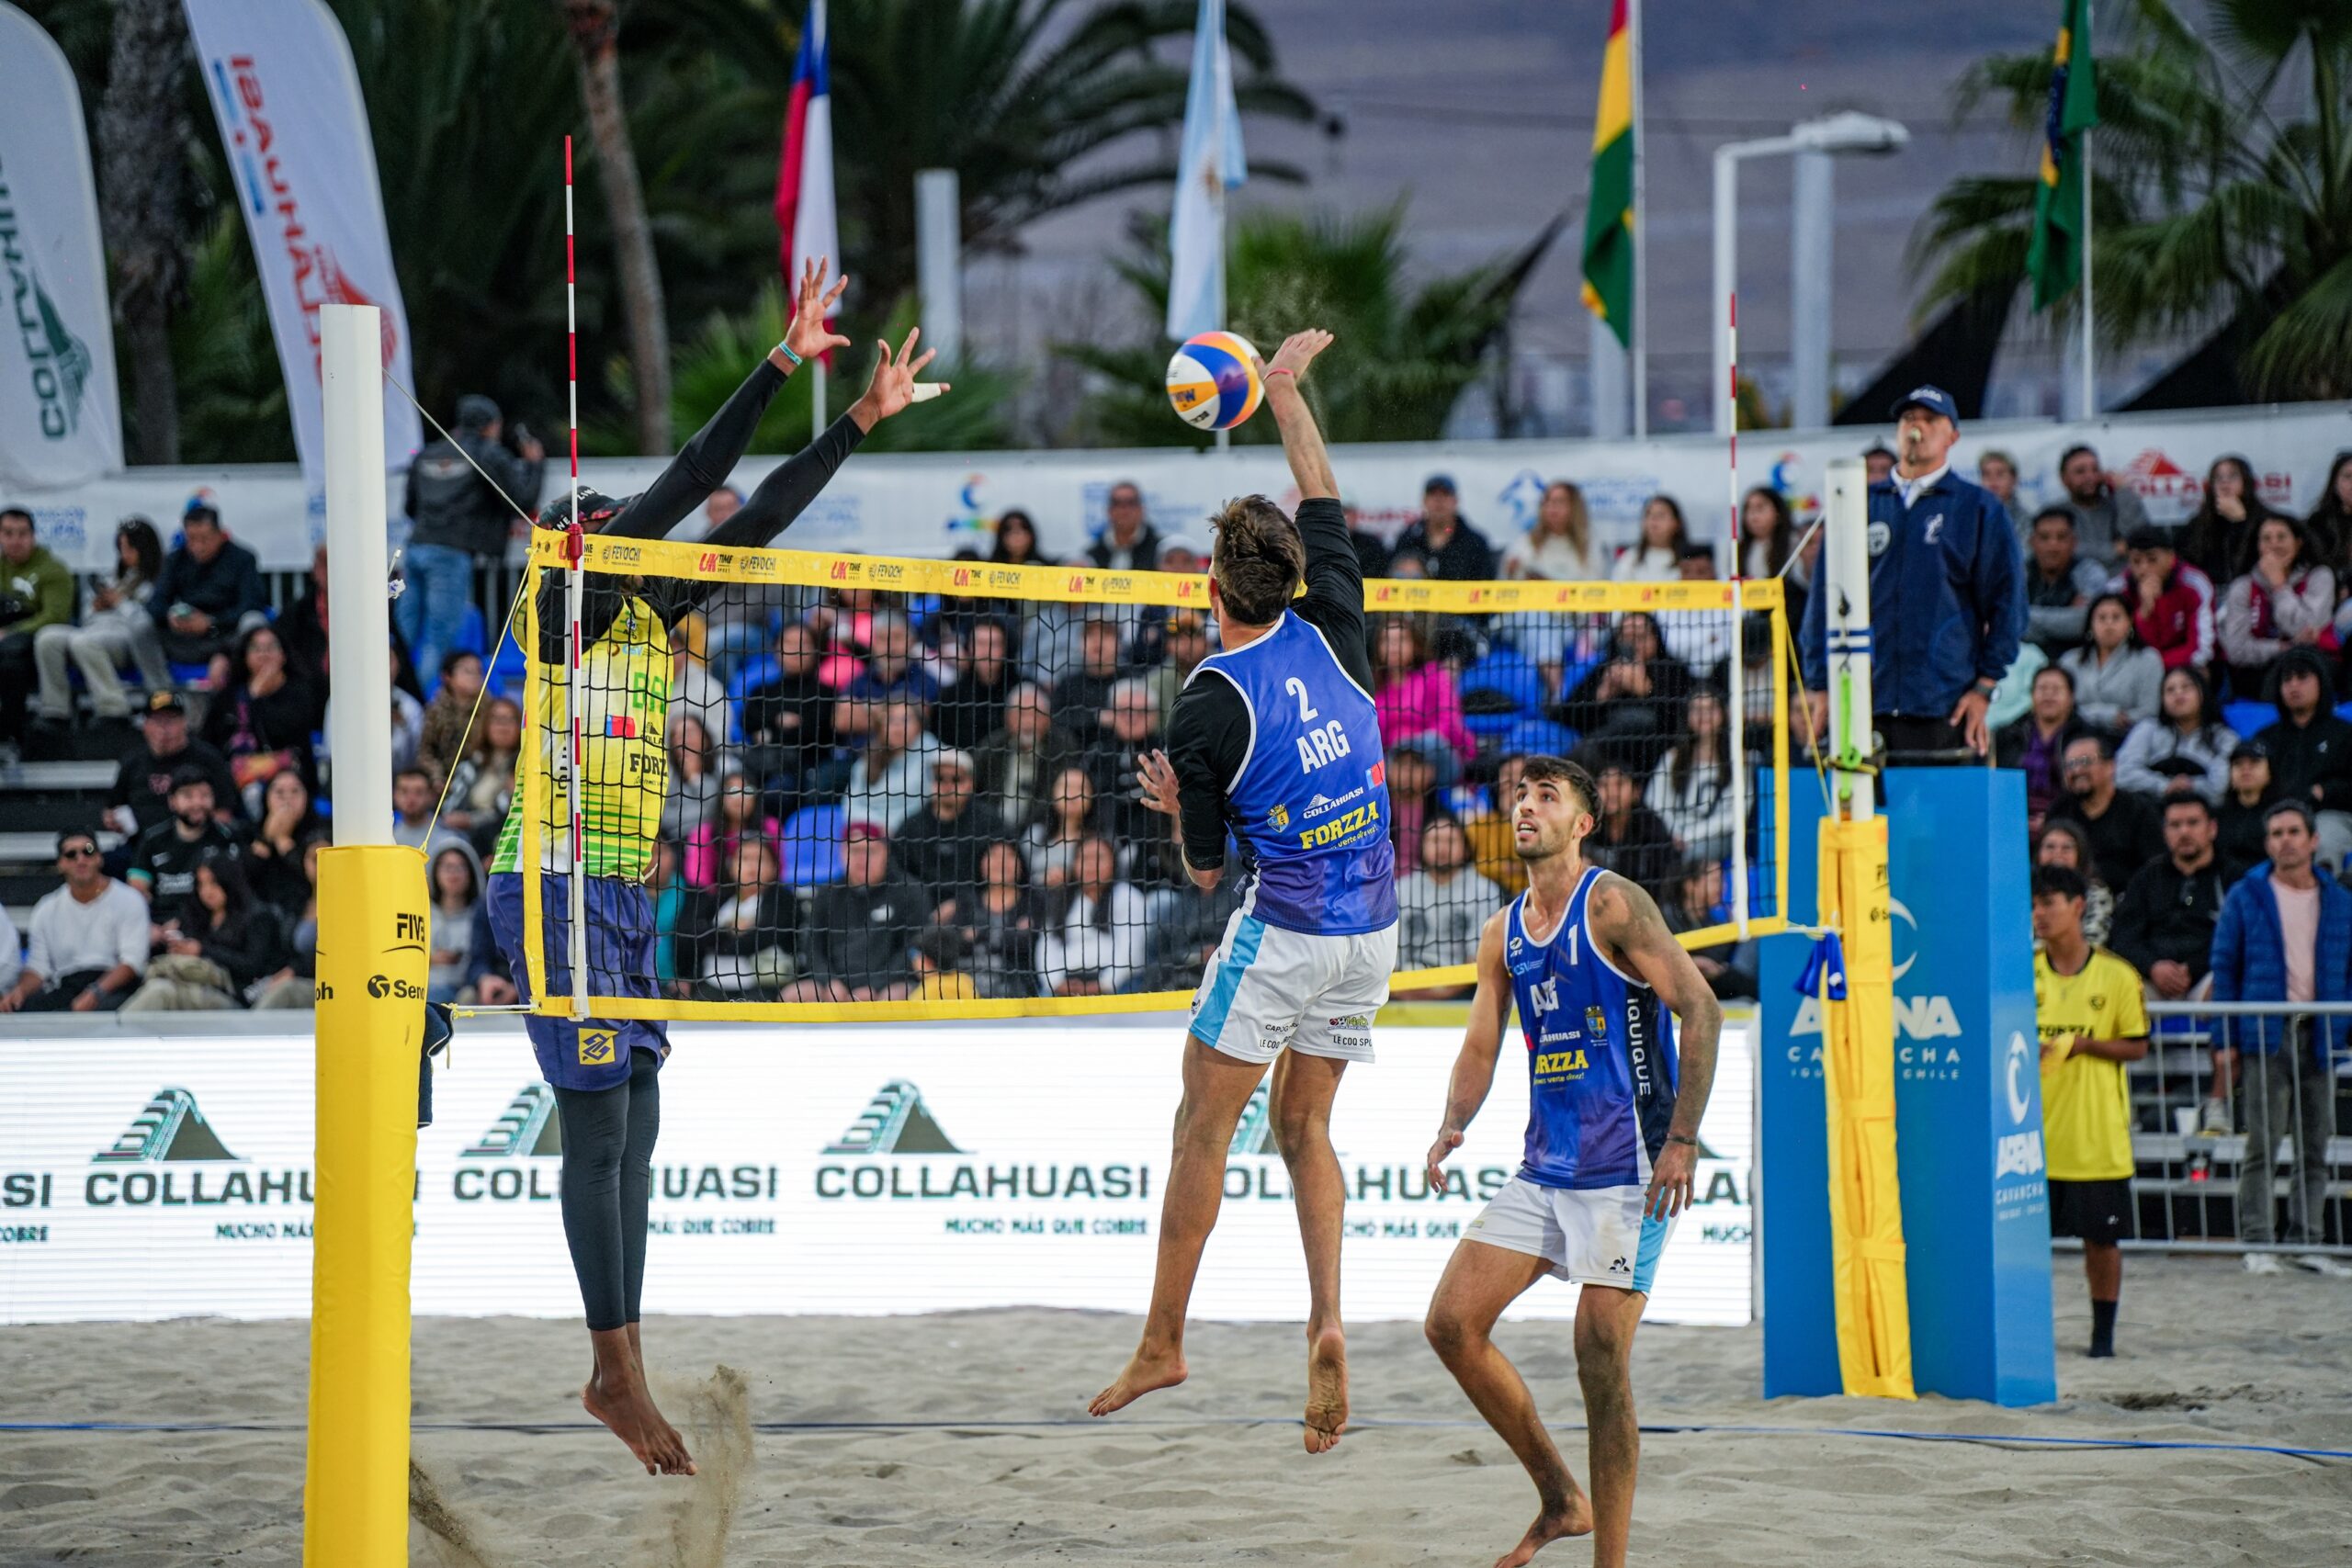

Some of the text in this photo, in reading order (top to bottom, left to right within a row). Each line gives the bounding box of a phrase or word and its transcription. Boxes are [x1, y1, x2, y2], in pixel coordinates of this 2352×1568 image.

[612, 546, 641, 559] FEVOCHI
[698, 553, 719, 572] UK
[718, 554, 733, 565] TIME
[749, 556, 776, 571] FEVOCHI
[831, 561, 850, 580] UK
[954, 569, 971, 586] UK
[1285, 676, 1318, 723] 2
[1296, 720, 1351, 774] ARG
[1304, 786, 1364, 819] COLLAHUASI
[1299, 801, 1380, 850] FORZZA
[1567, 923, 1578, 965] 1
[1333, 1035, 1340, 1044] LE
[1342, 1037, 1358, 1046] COQ
[1626, 998, 1652, 1097] IQUIQUE
[815, 1165, 1149, 1200] COLLAHUASI
